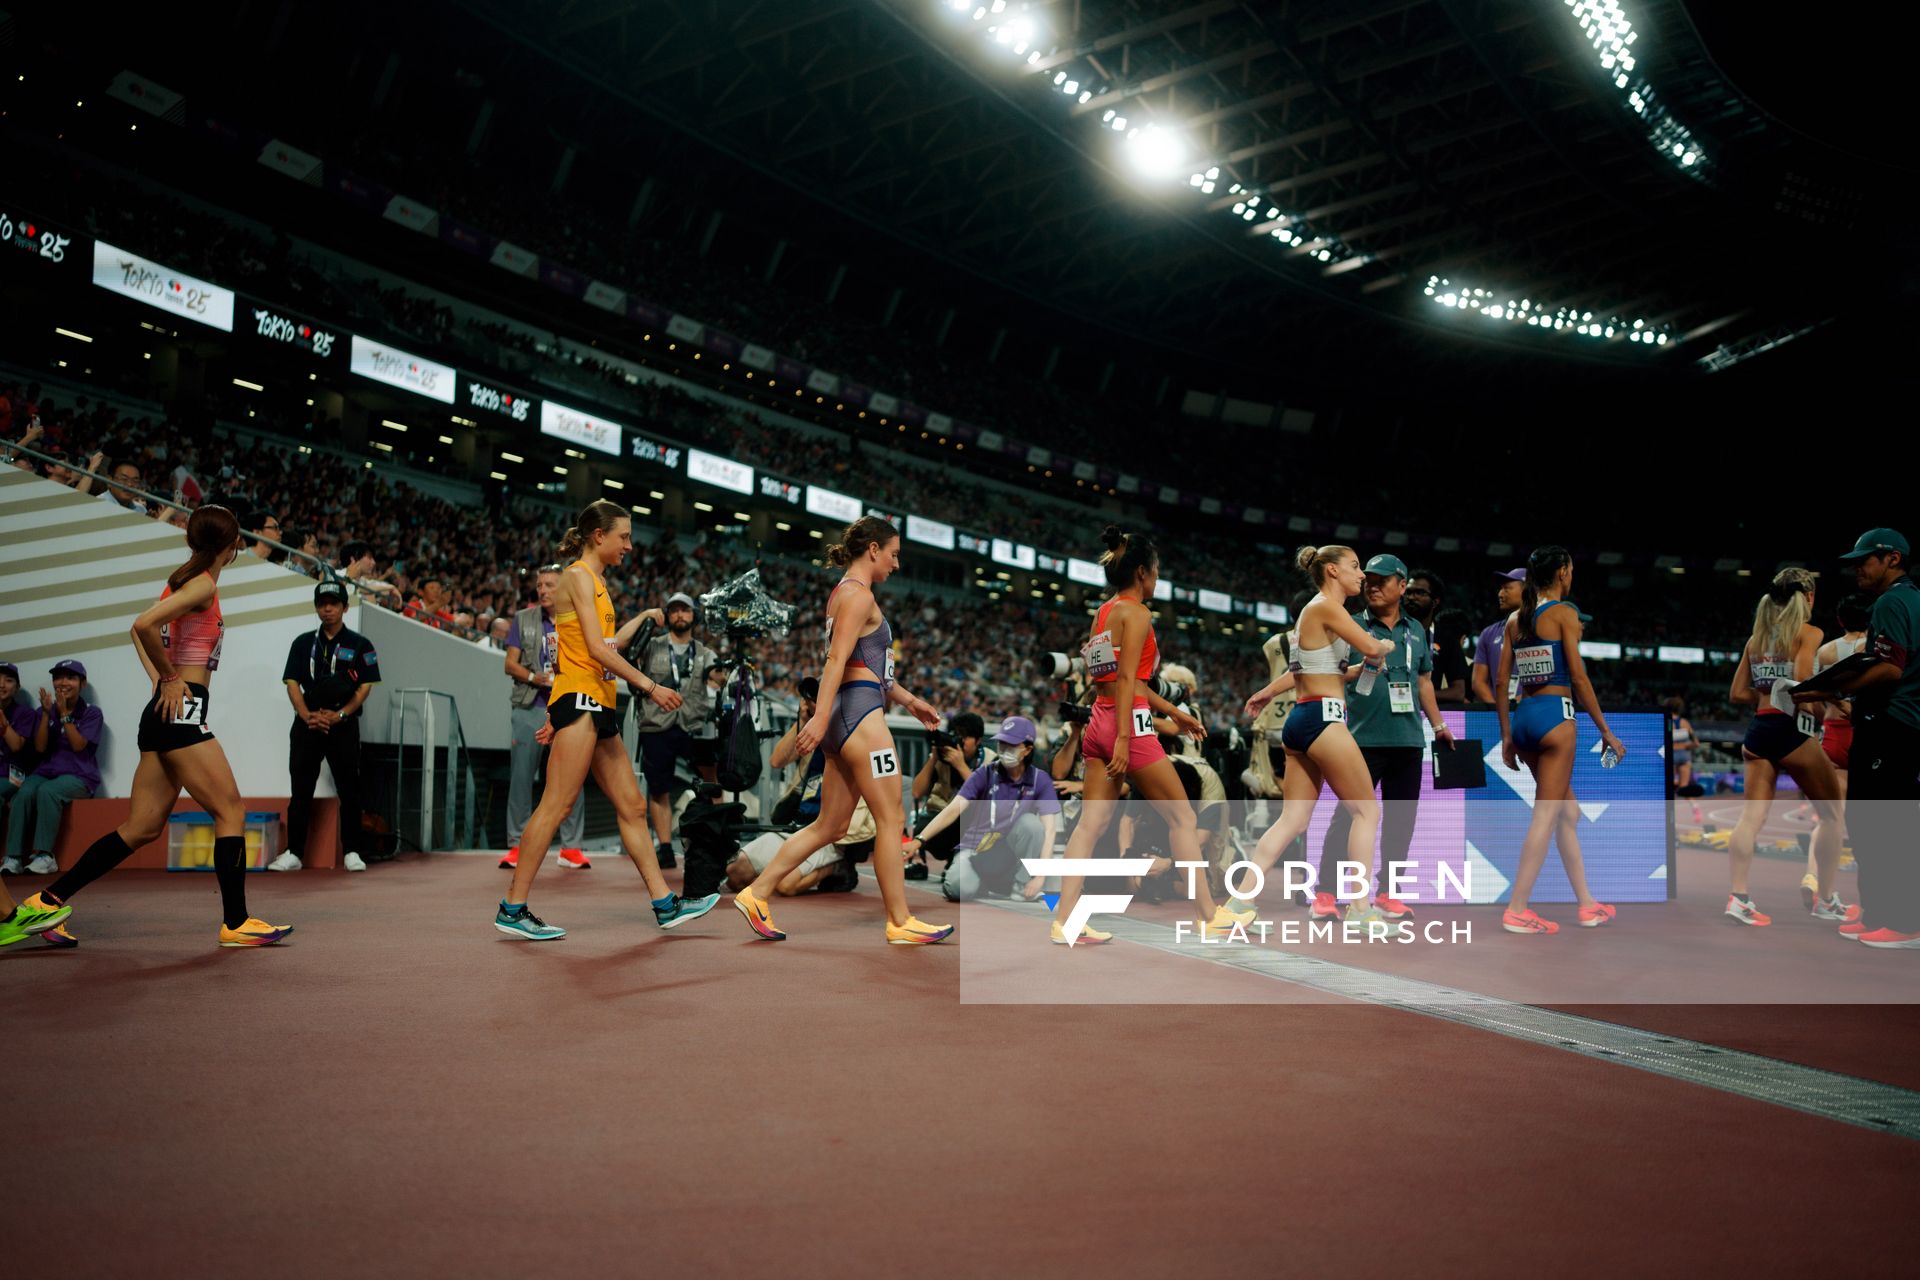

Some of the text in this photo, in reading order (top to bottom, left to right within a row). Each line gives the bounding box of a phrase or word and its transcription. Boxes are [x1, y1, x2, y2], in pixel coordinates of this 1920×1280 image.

[40, 231, 71, 263] 25
[118, 260, 212, 314] TOKYO 25
[254, 310, 336, 357] TOKYO 25
[420, 369, 440, 390] 25
[511, 398, 530, 421] 25
[1091, 650, 1101, 664] HE
[1327, 702, 1342, 718] 13
[1136, 714, 1154, 732] 14
[1801, 715, 1811, 732] 11
[873, 753, 895, 774] 15
